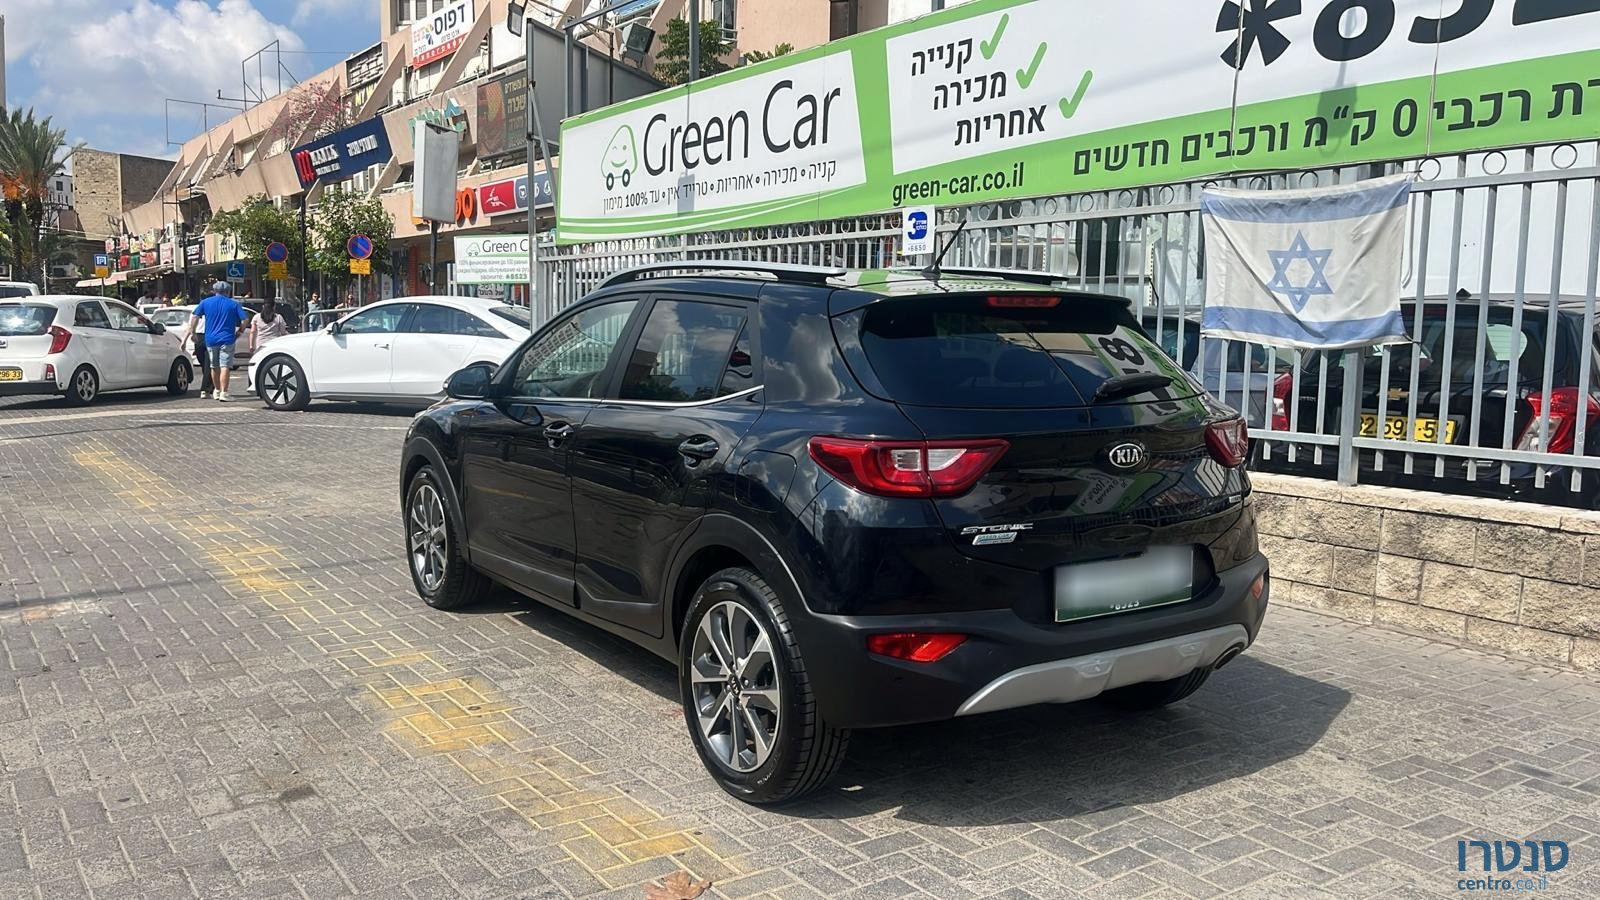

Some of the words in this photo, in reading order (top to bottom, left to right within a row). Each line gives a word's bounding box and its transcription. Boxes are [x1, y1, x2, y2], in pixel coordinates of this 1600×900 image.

[434, 4, 465, 35] דפוס
[911, 38, 973, 77] קנייה
[933, 71, 1006, 111] מכירה
[1392, 98, 1418, 138] 0
[1432, 89, 1532, 132] רכבי
[643, 109, 750, 177] Green
[762, 79, 841, 154] Car
[954, 105, 1047, 147] אחריות
[1181, 122, 1289, 163] ורכבים
[1073, 137, 1170, 176] חדשים
[715, 174, 754, 194] אחריות
[763, 166, 798, 187] מכירה
[808, 160, 837, 182] קניה
[892, 161, 1025, 206] green-car.co.il
[603, 196, 623, 215] מימון
[625, 191, 648, 208] 100%
[649, 189, 660, 203] עד
[667, 186, 680, 205] אין
[482, 239, 517, 253] Green
[1116, 449, 1140, 464] KIA
[960, 522, 1034, 535] STONIC
